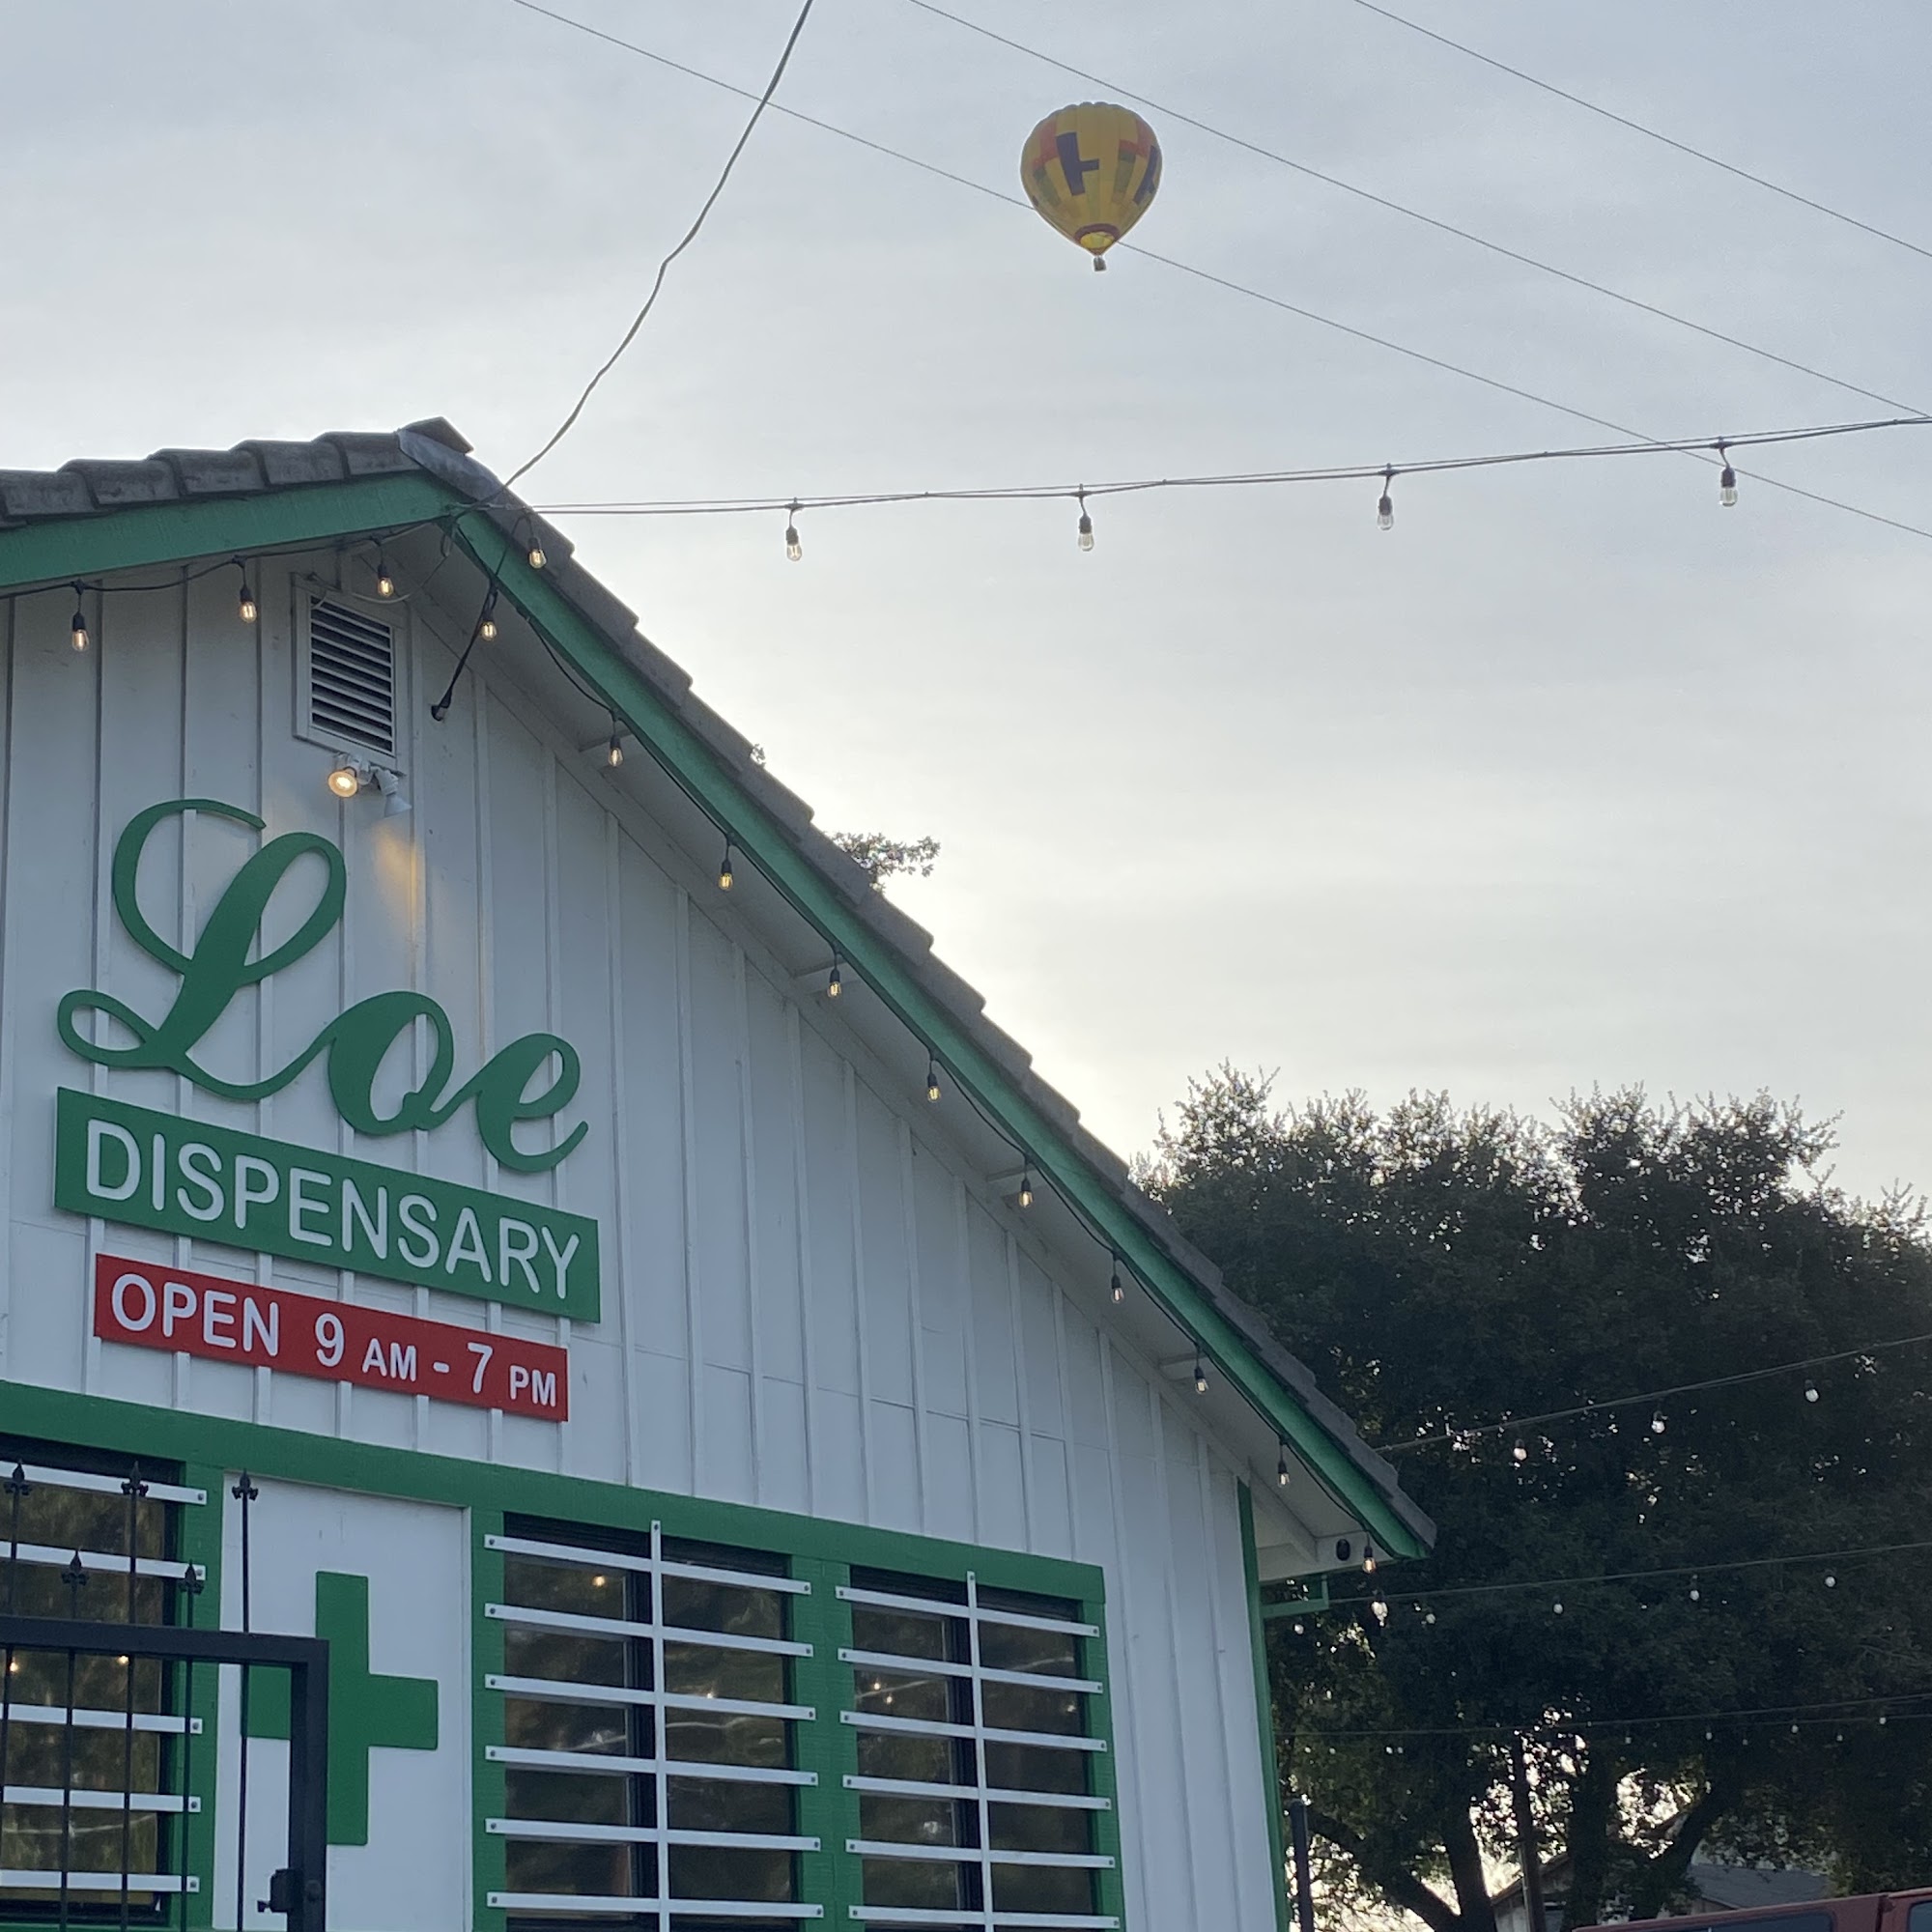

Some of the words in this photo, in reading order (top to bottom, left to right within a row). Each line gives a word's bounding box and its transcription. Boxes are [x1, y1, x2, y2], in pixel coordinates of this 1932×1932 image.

[57, 798, 589, 1173] Loe
[86, 1118, 581, 1300] DISPENSARY
[110, 1272, 280, 1357] OPEN
[314, 1313, 346, 1369] 9
[361, 1338, 418, 1383] AM
[432, 1362, 451, 1375] -
[466, 1342, 494, 1393] 7
[508, 1363, 557, 1407] PM
